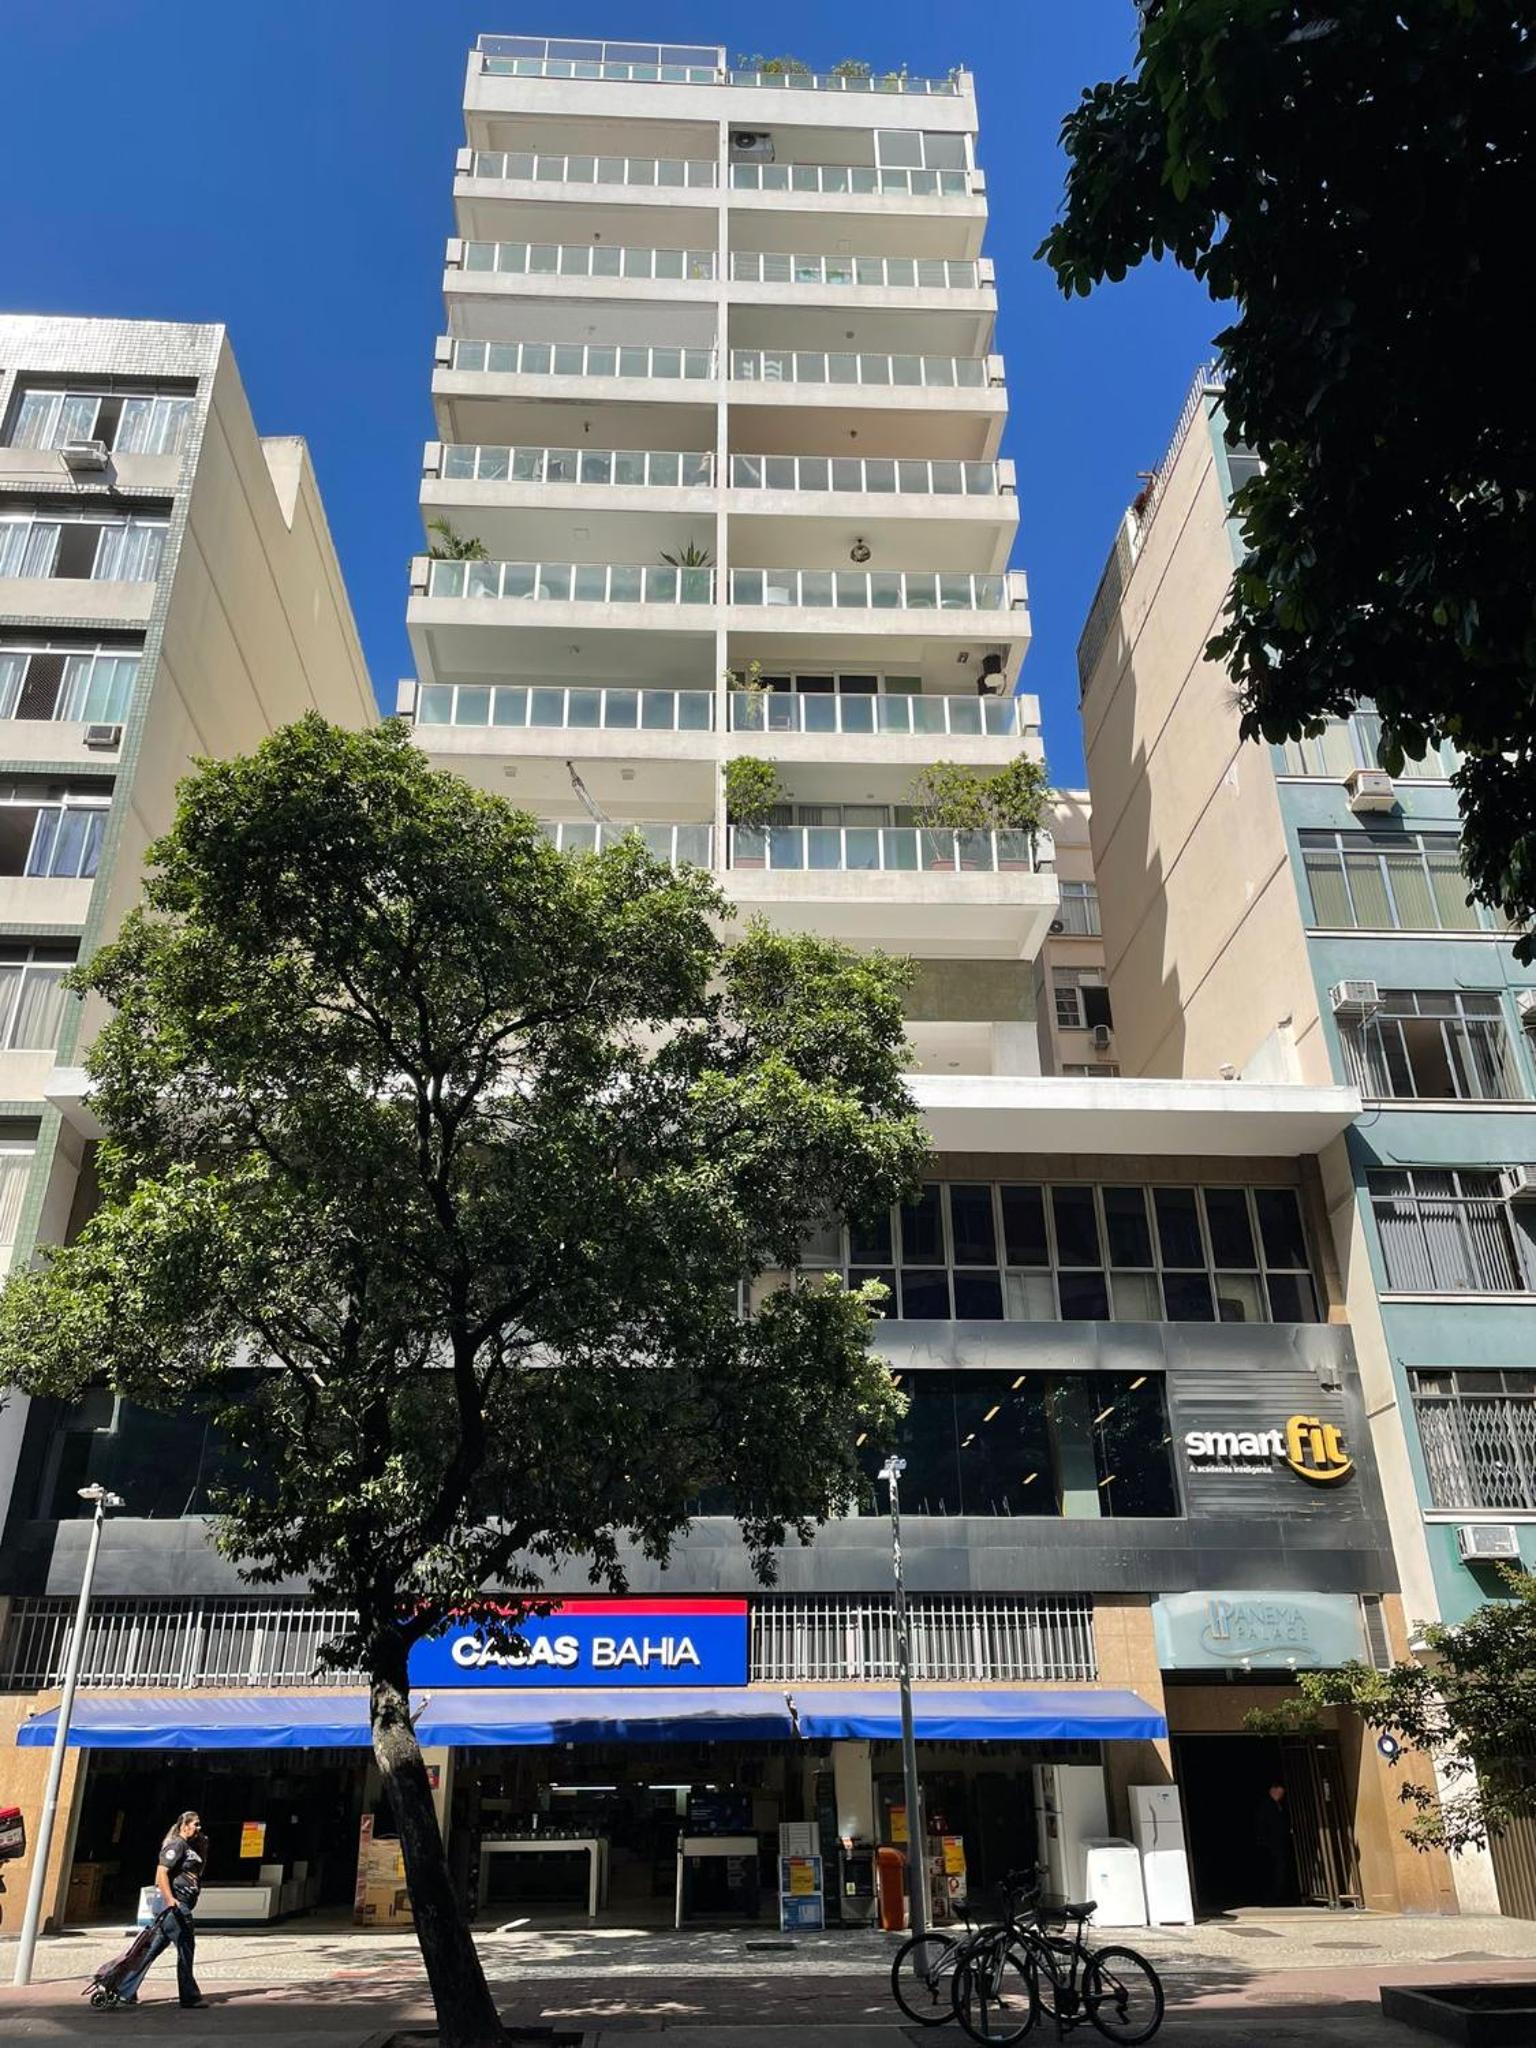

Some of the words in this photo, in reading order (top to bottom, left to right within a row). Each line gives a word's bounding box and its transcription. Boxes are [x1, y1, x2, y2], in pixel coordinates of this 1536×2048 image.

[1185, 1429, 1286, 1457] smart
[1286, 1415, 1348, 1463] fit
[1237, 1626, 1309, 1641] PALACE
[592, 1636, 700, 1667] BAHIA
